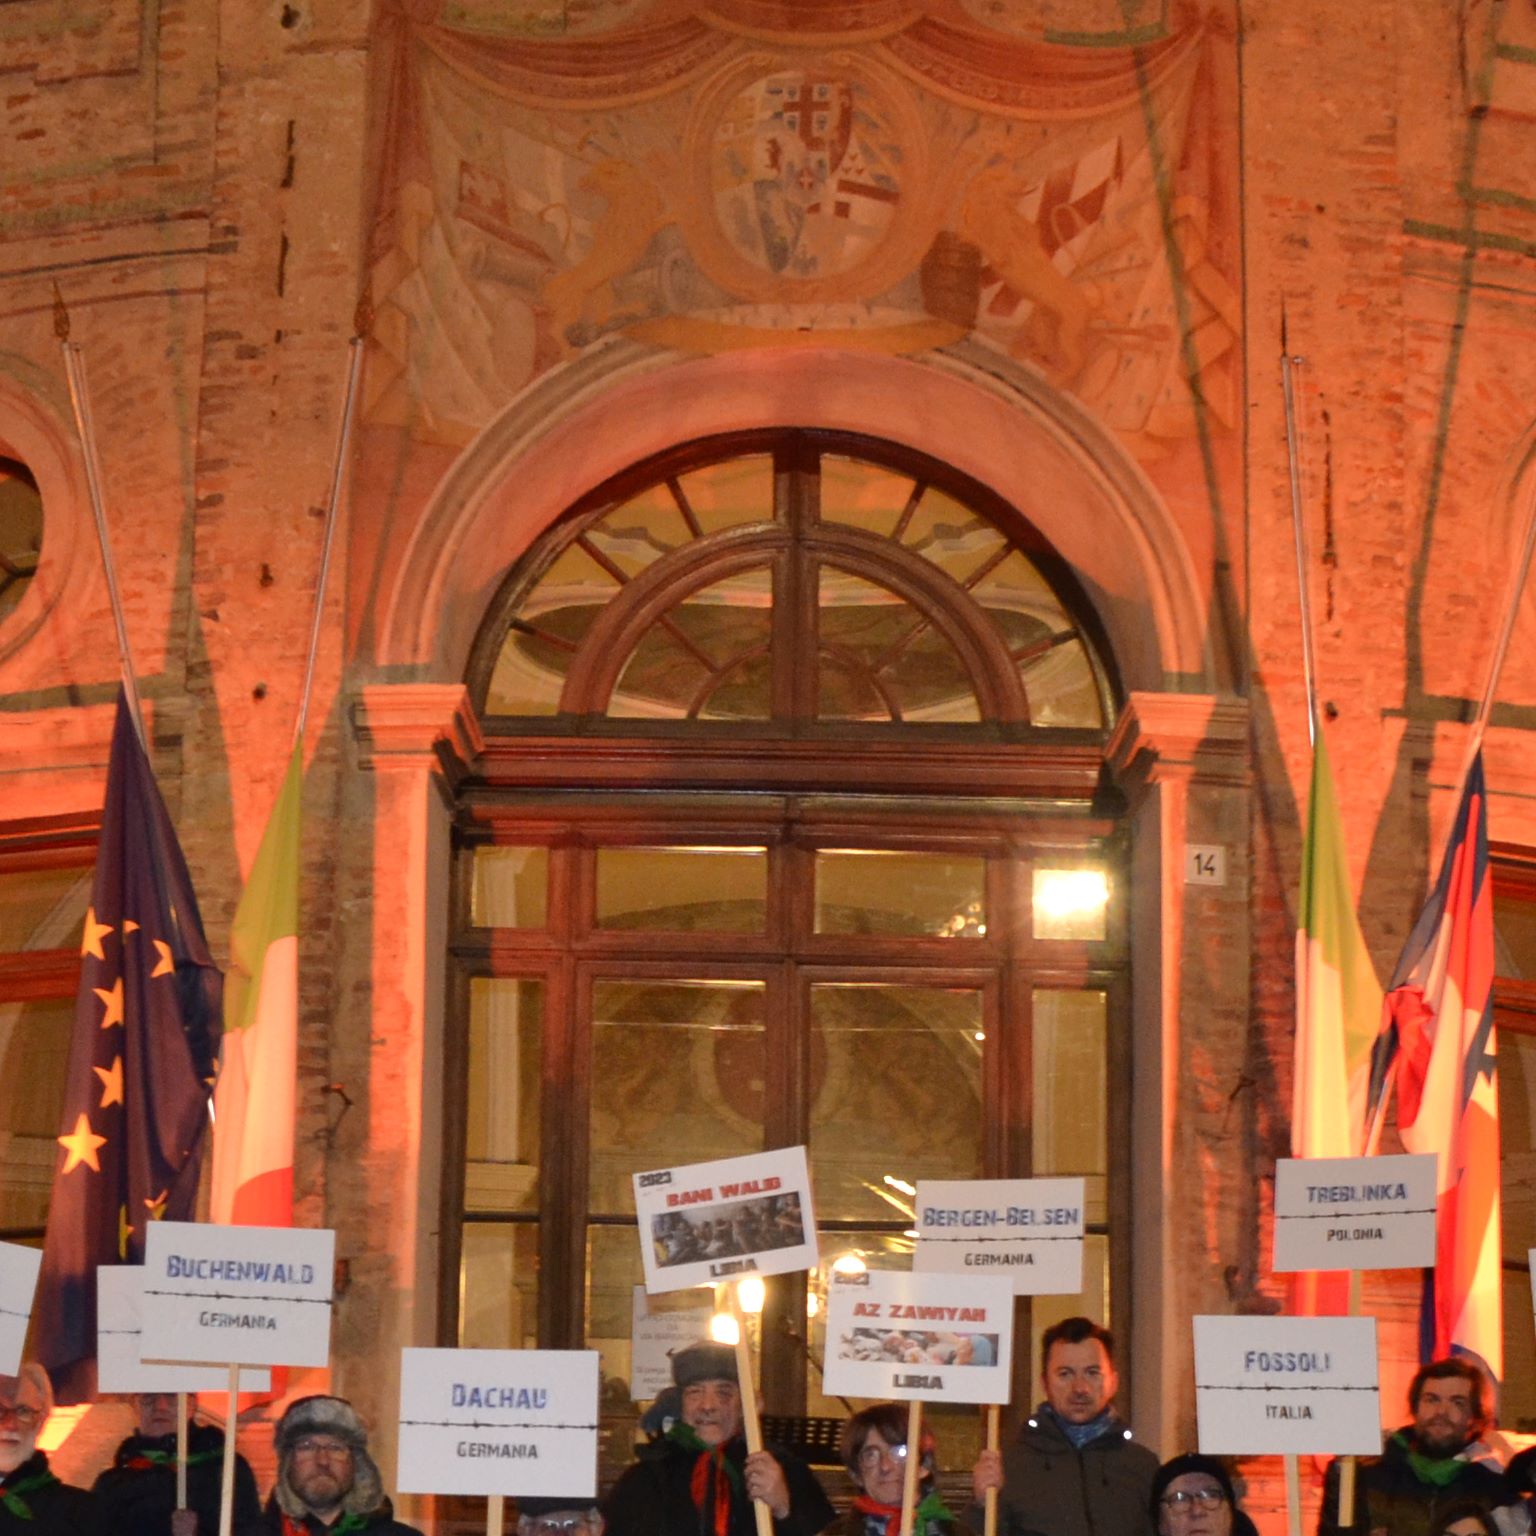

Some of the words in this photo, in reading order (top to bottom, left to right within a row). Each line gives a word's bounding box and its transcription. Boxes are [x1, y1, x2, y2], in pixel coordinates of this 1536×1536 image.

[1194, 853, 1216, 877] 14
[666, 1188, 714, 1207] BANI
[1306, 1183, 1408, 1203] TREBLINKA
[923, 1207, 1078, 1227] BERGEN-BELSEN
[1327, 1228, 1384, 1242] POLONIA
[166, 1255, 314, 1284] BUCHENWALD
[709, 1258, 758, 1278] LIBIA
[964, 1253, 1034, 1266] GERMANIA
[853, 1303, 881, 1318] AZ
[199, 1311, 277, 1331] GERMANIA
[1244, 1351, 1330, 1373] FOSSOLI
[892, 1374, 943, 1390] LIBIA
[451, 1383, 548, 1410] DACHAU
[1265, 1404, 1313, 1420] ITALIA
[457, 1441, 538, 1459] GERMANIA
